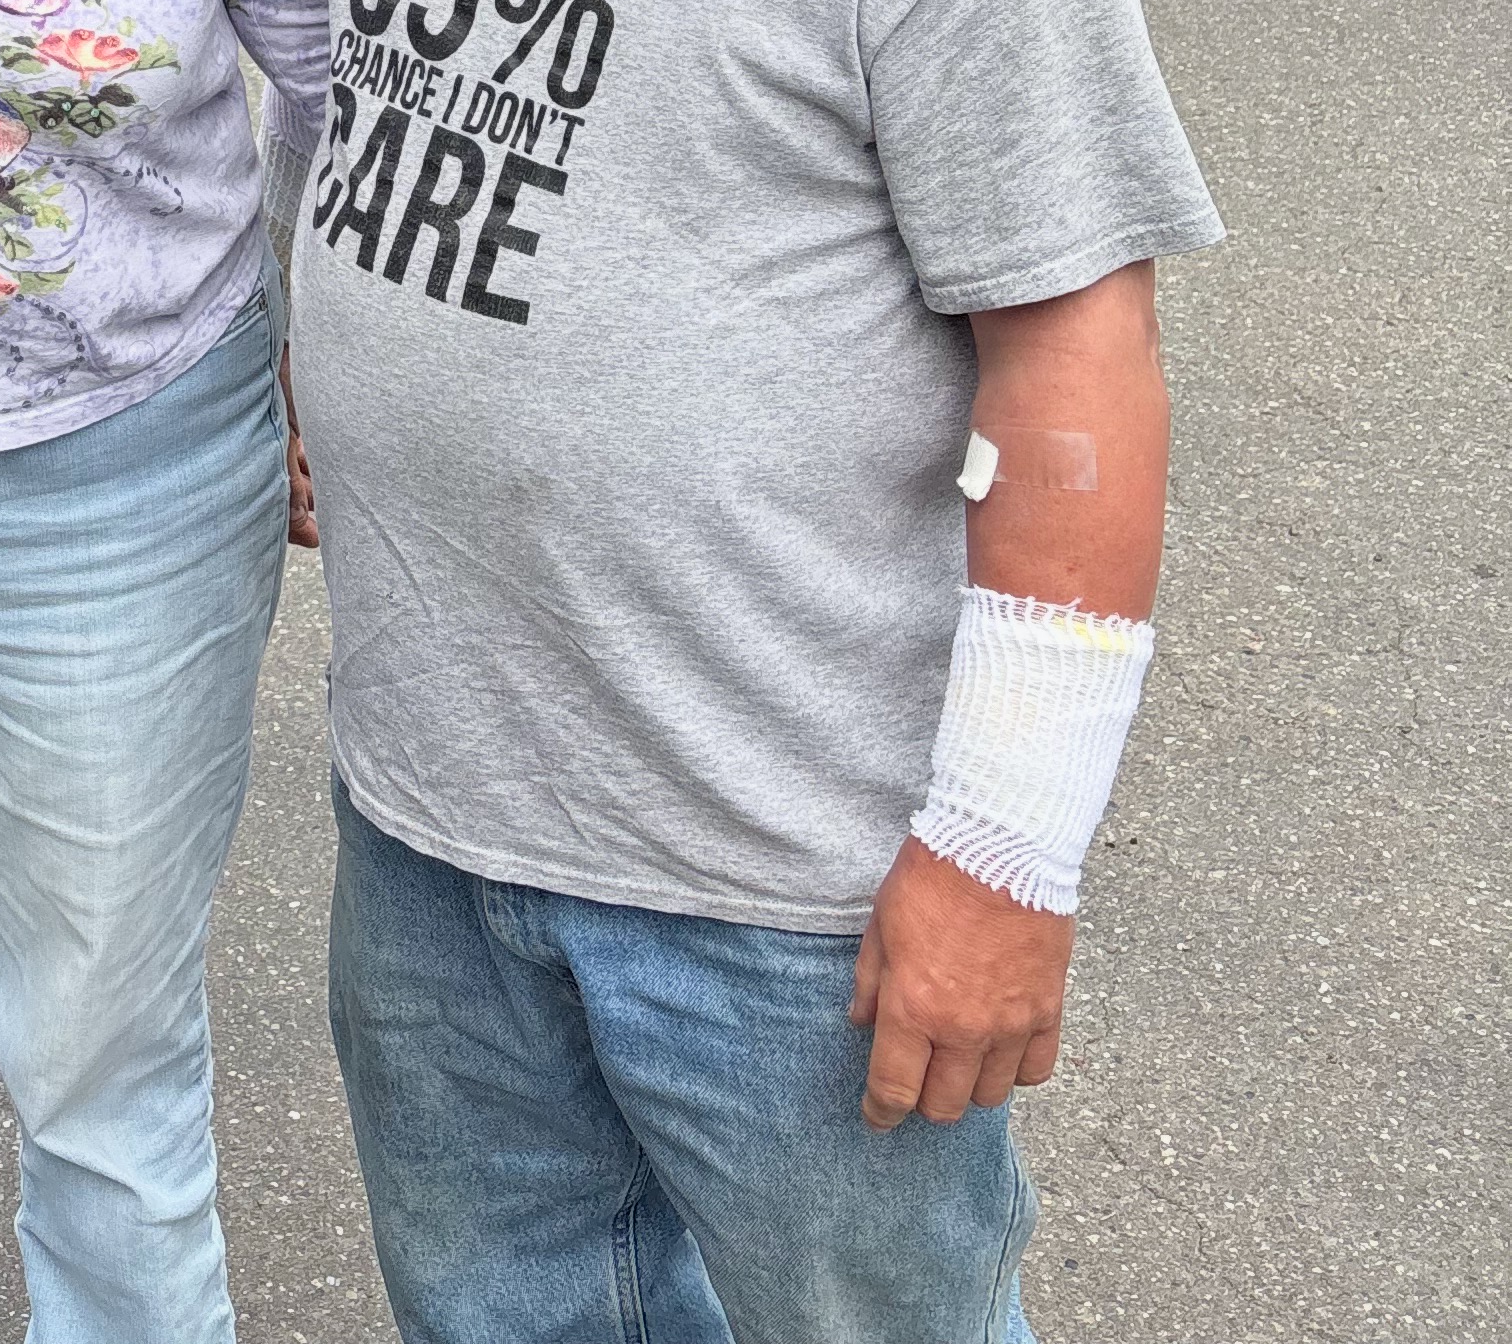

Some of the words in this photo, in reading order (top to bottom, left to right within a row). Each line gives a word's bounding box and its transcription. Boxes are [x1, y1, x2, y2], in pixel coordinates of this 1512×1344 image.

[331, 28, 443, 119] CHANCE
[447, 74, 464, 124] I
[461, 81, 585, 166] DON'T
